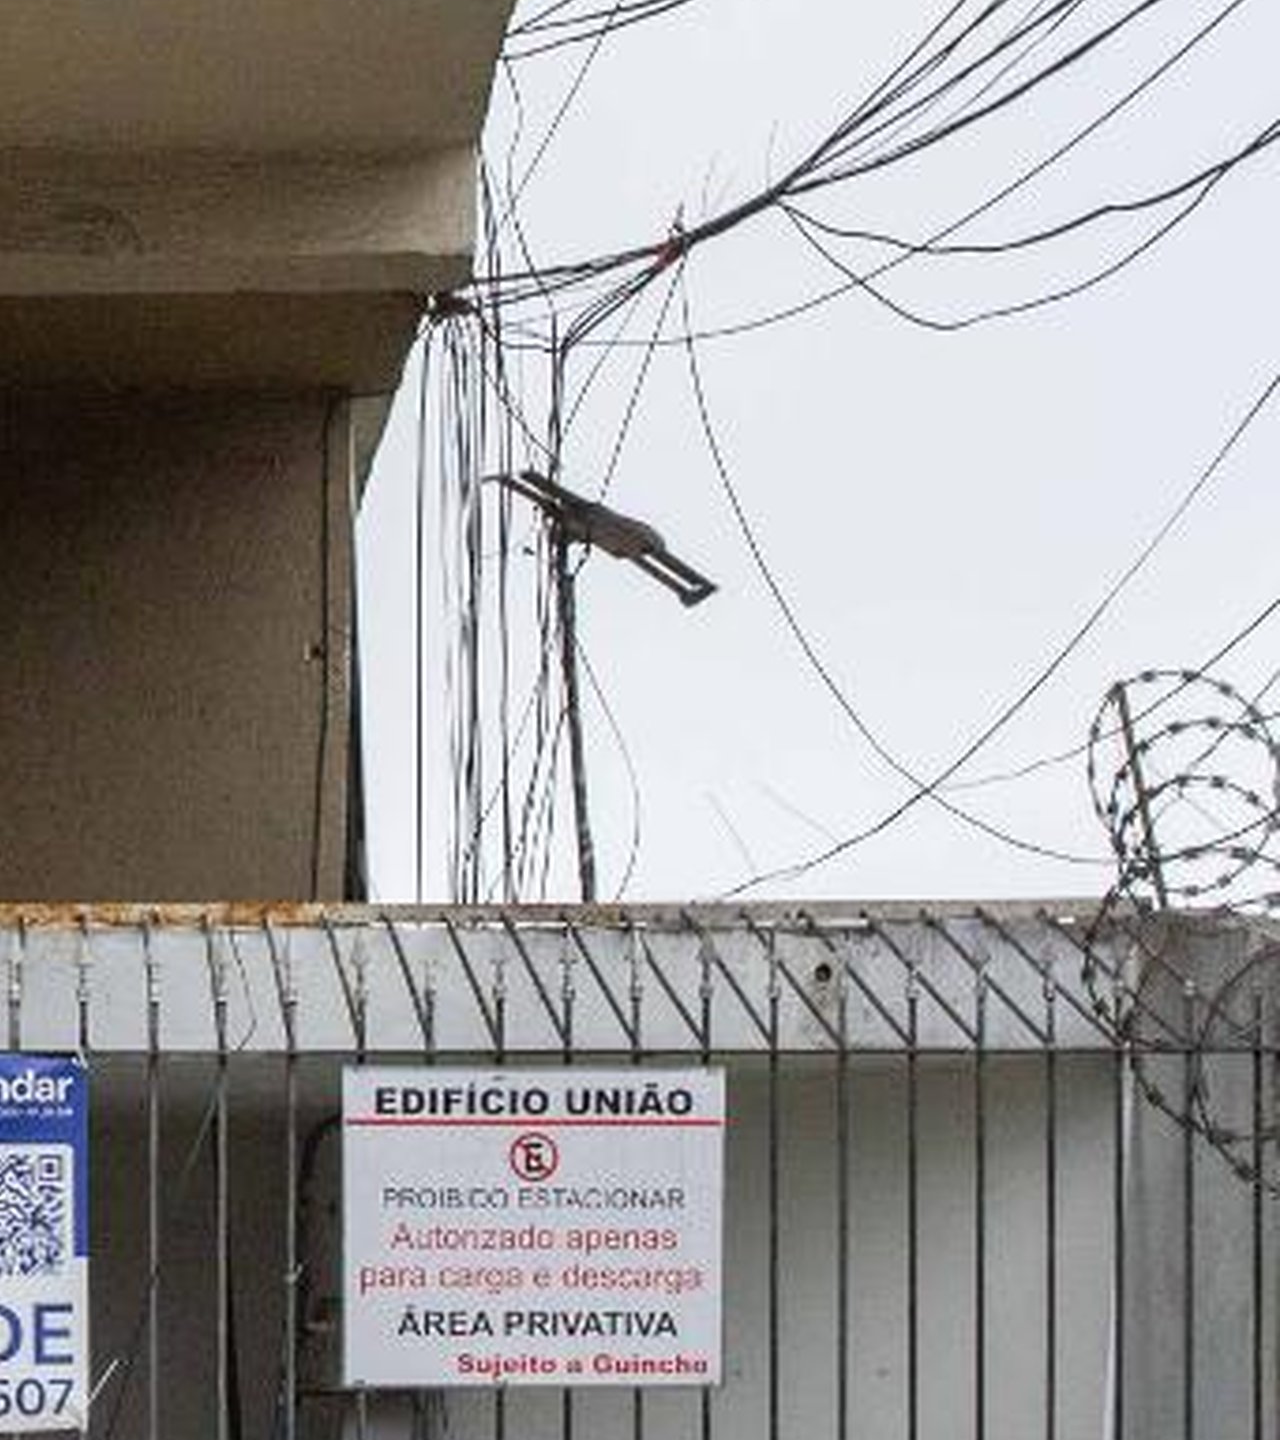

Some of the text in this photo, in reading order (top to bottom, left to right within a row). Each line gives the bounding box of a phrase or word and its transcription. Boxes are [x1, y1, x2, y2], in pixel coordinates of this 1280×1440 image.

[375, 1081, 694, 1116] EDIFÍCIO UNIÃO
[383, 1188, 686, 1210] PROIBIDO ESTACIONAR
[390, 1223, 678, 1258] Autorizado apenas
[360, 1264, 702, 1295] para carga e descarga
[397, 1305, 679, 1337] ÁREA PRIVATIVA
[458, 1353, 708, 1380] Sujeito a Guincho
